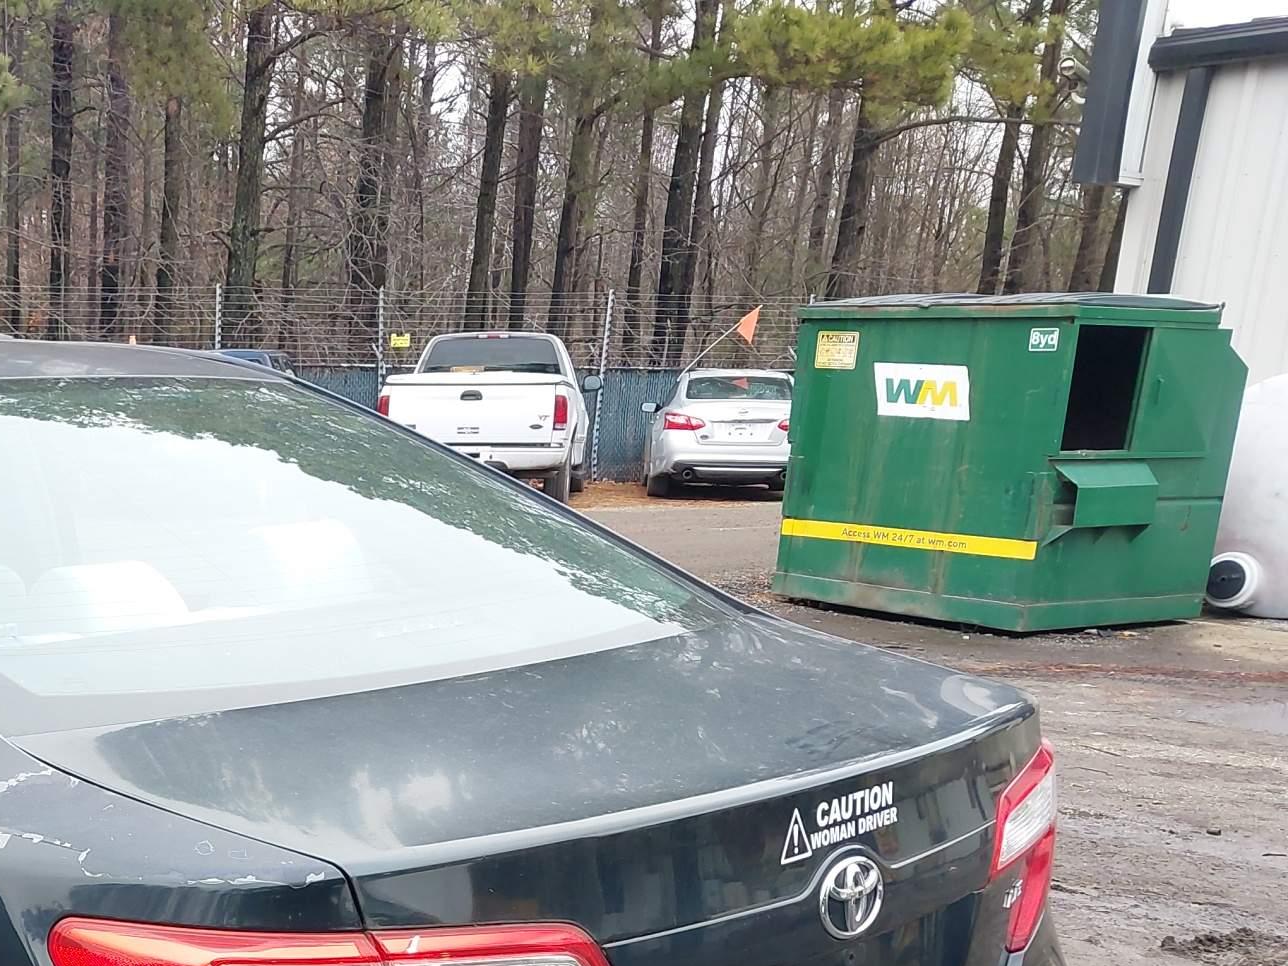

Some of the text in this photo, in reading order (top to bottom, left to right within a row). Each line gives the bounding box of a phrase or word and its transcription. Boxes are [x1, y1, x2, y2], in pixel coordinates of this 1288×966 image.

[829, 335, 855, 343] CAUTION
[886, 378, 958, 407] WM
[841, 527, 967, 549] Access WM 24/7 at wm.com
[816, 781, 893, 827] CAUTION
[810, 807, 898, 850] WOMAN DRIVER
